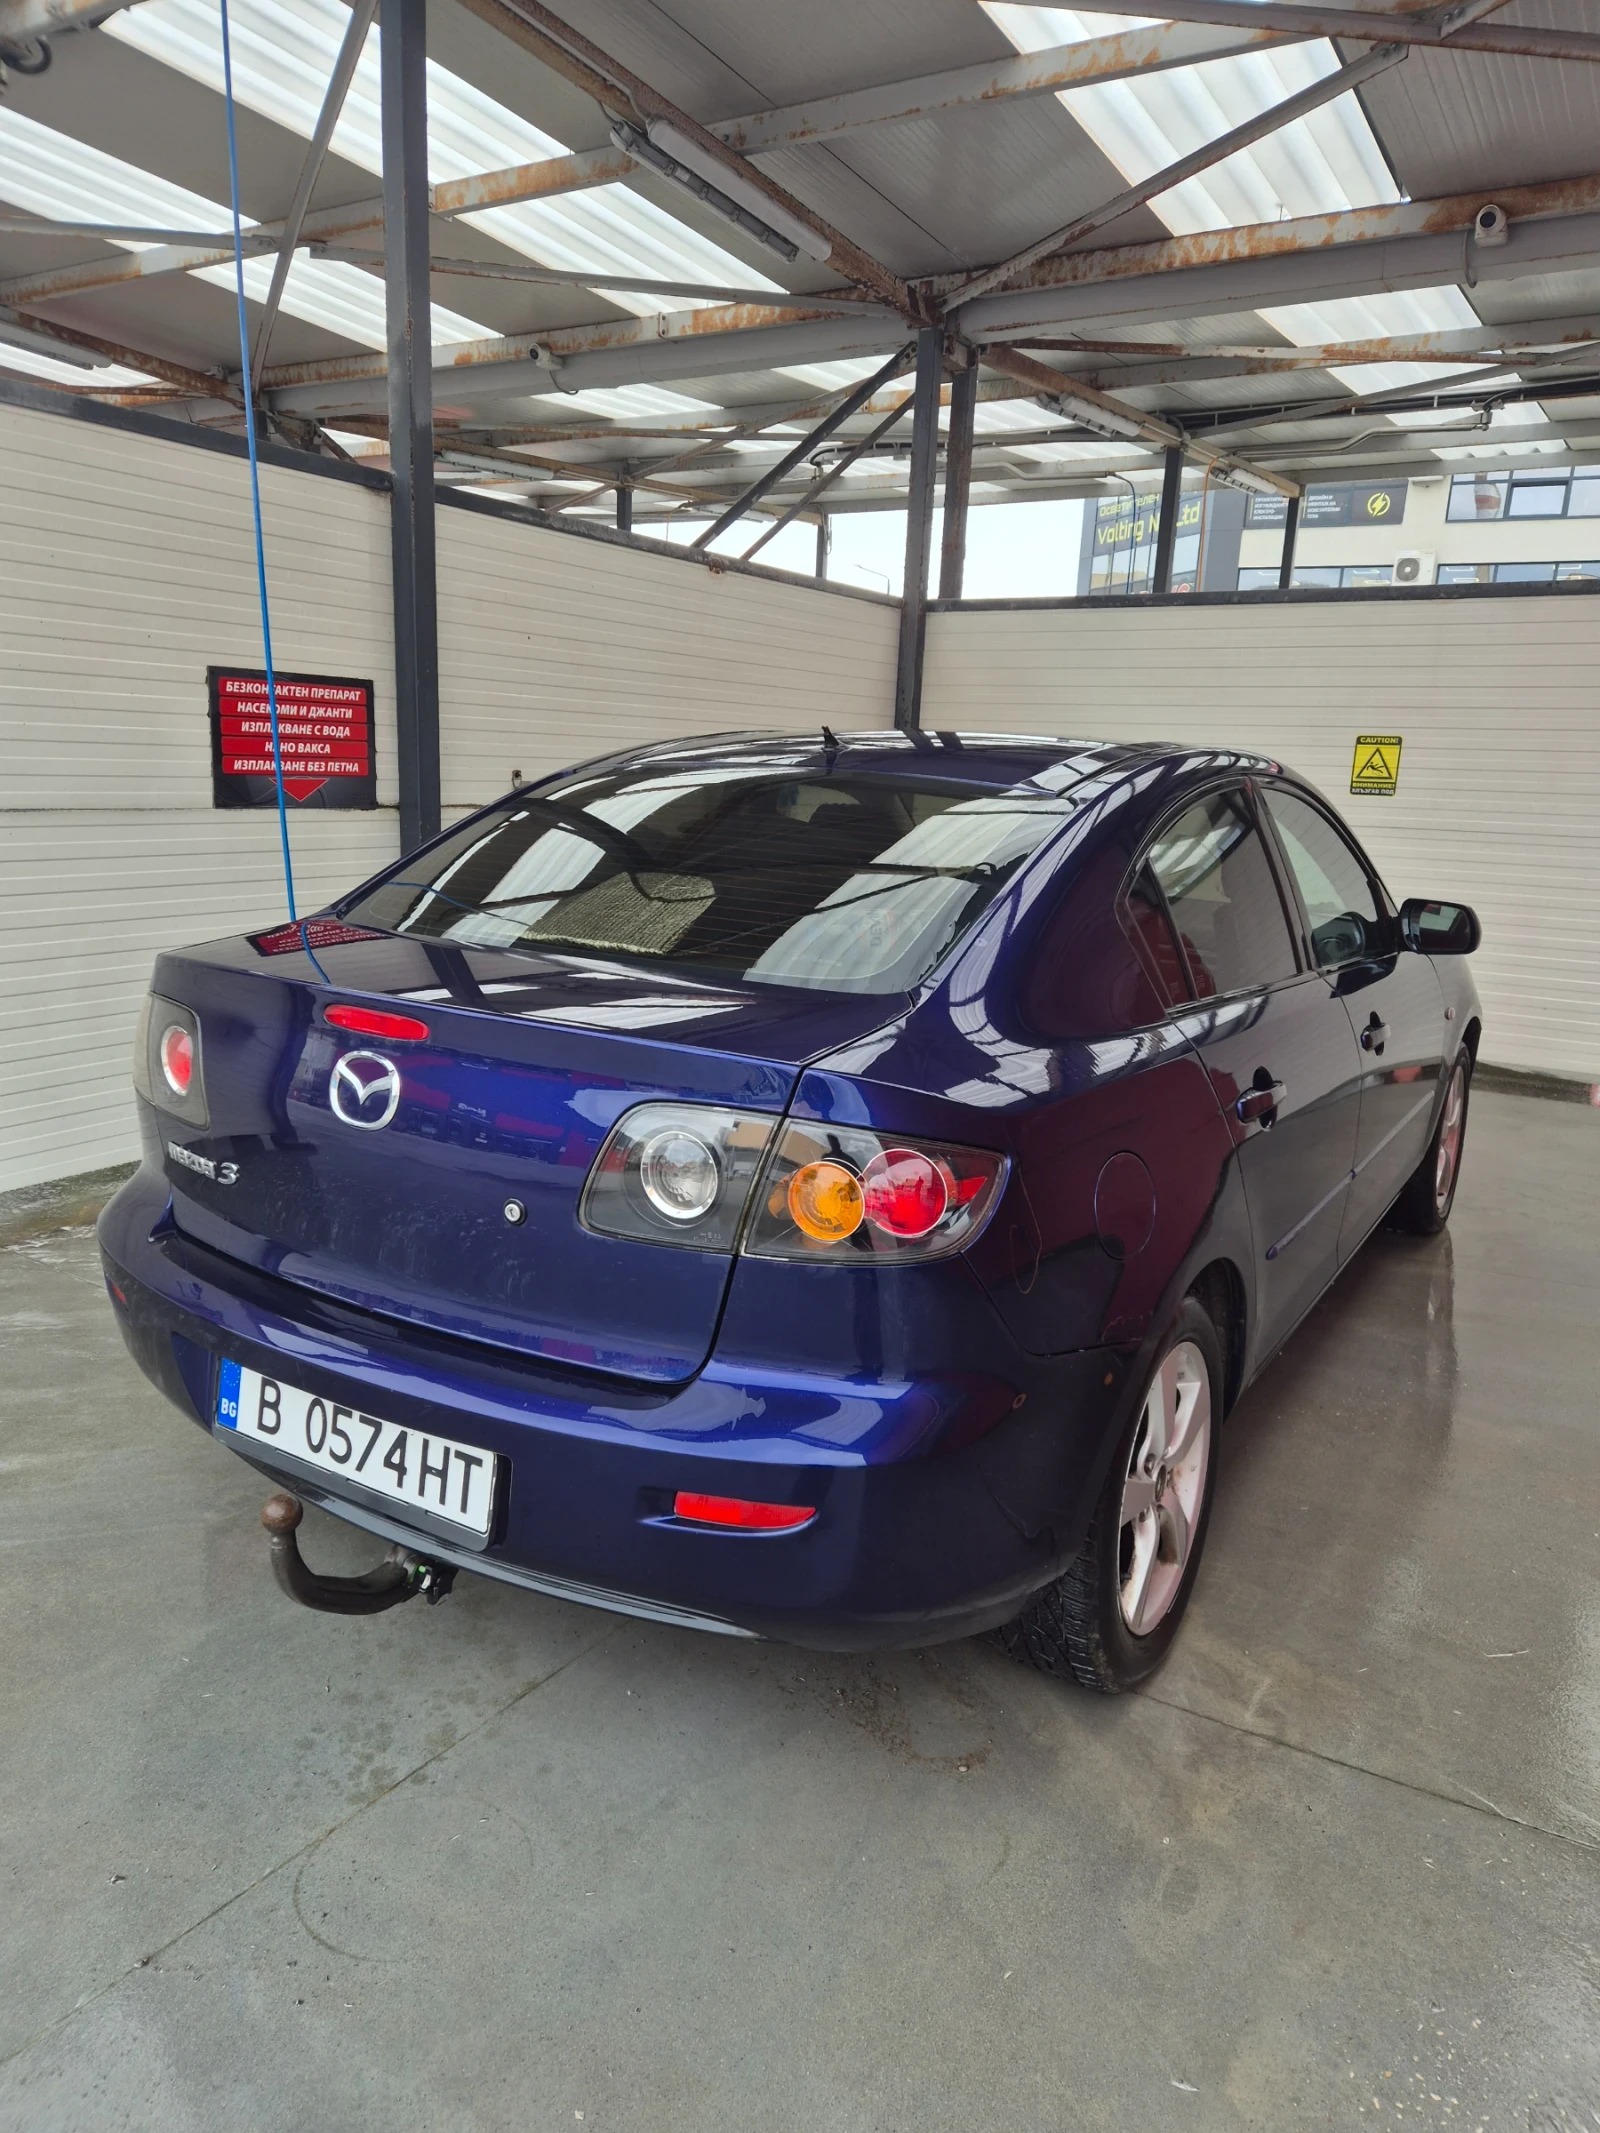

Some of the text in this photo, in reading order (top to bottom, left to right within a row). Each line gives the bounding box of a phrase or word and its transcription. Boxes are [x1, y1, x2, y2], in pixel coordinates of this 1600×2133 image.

[226, 681, 361, 701] БЕЗКОНАКТЕН ПРЕПАРАТ
[299, 706, 308, 716] И
[308, 706, 353, 719] ДЖАНТИ
[241, 721, 350, 738] ИЗПЛКВАНЕ С ВОДА
[265, 741, 331, 754] ННО ВАКСА
[307, 761, 325, 772] БЕЗ
[327, 762, 359, 773] ПЕТНА
[217, 1161, 240, 1185] 3
[220, 1397, 237, 1418] BG
[257, 1376, 281, 1435] B
